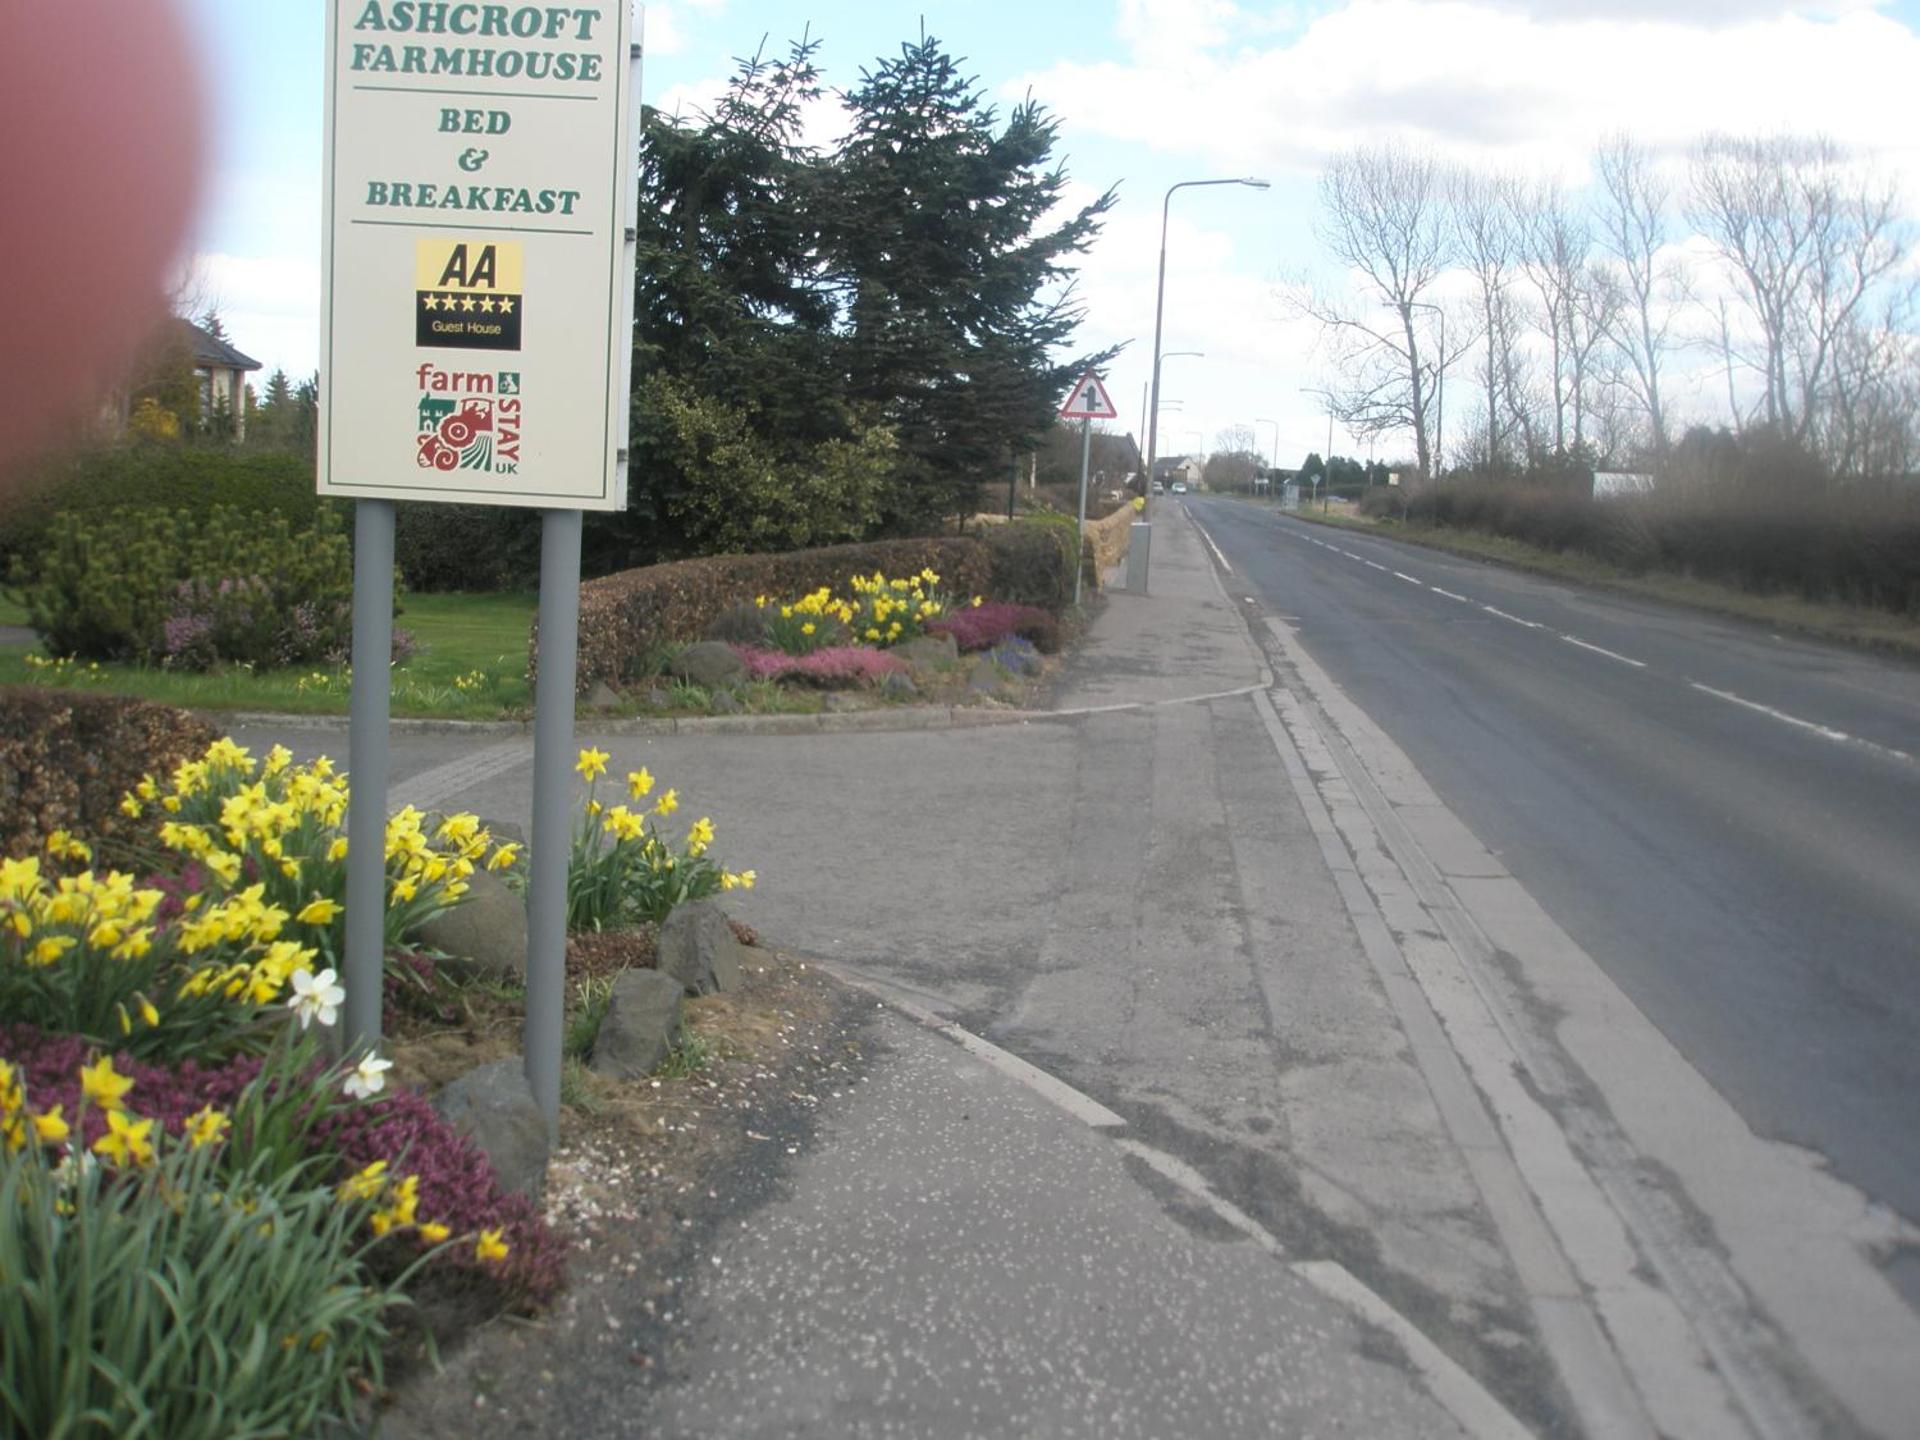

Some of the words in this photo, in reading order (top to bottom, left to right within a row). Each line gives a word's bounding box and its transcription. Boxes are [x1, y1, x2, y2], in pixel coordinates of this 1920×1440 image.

[354, 0, 601, 40] ASHCROFT
[350, 43, 603, 82] FARMHOUSE
[438, 108, 511, 135] BED
[458, 148, 489, 172] &
[366, 181, 581, 215] BREAKFAST
[438, 243, 496, 288] AA
[432, 320, 464, 333] Guest
[467, 322, 502, 335] House
[416, 363, 494, 393] farm
[497, 398, 521, 462] STAY
[495, 463, 518, 475] UK
